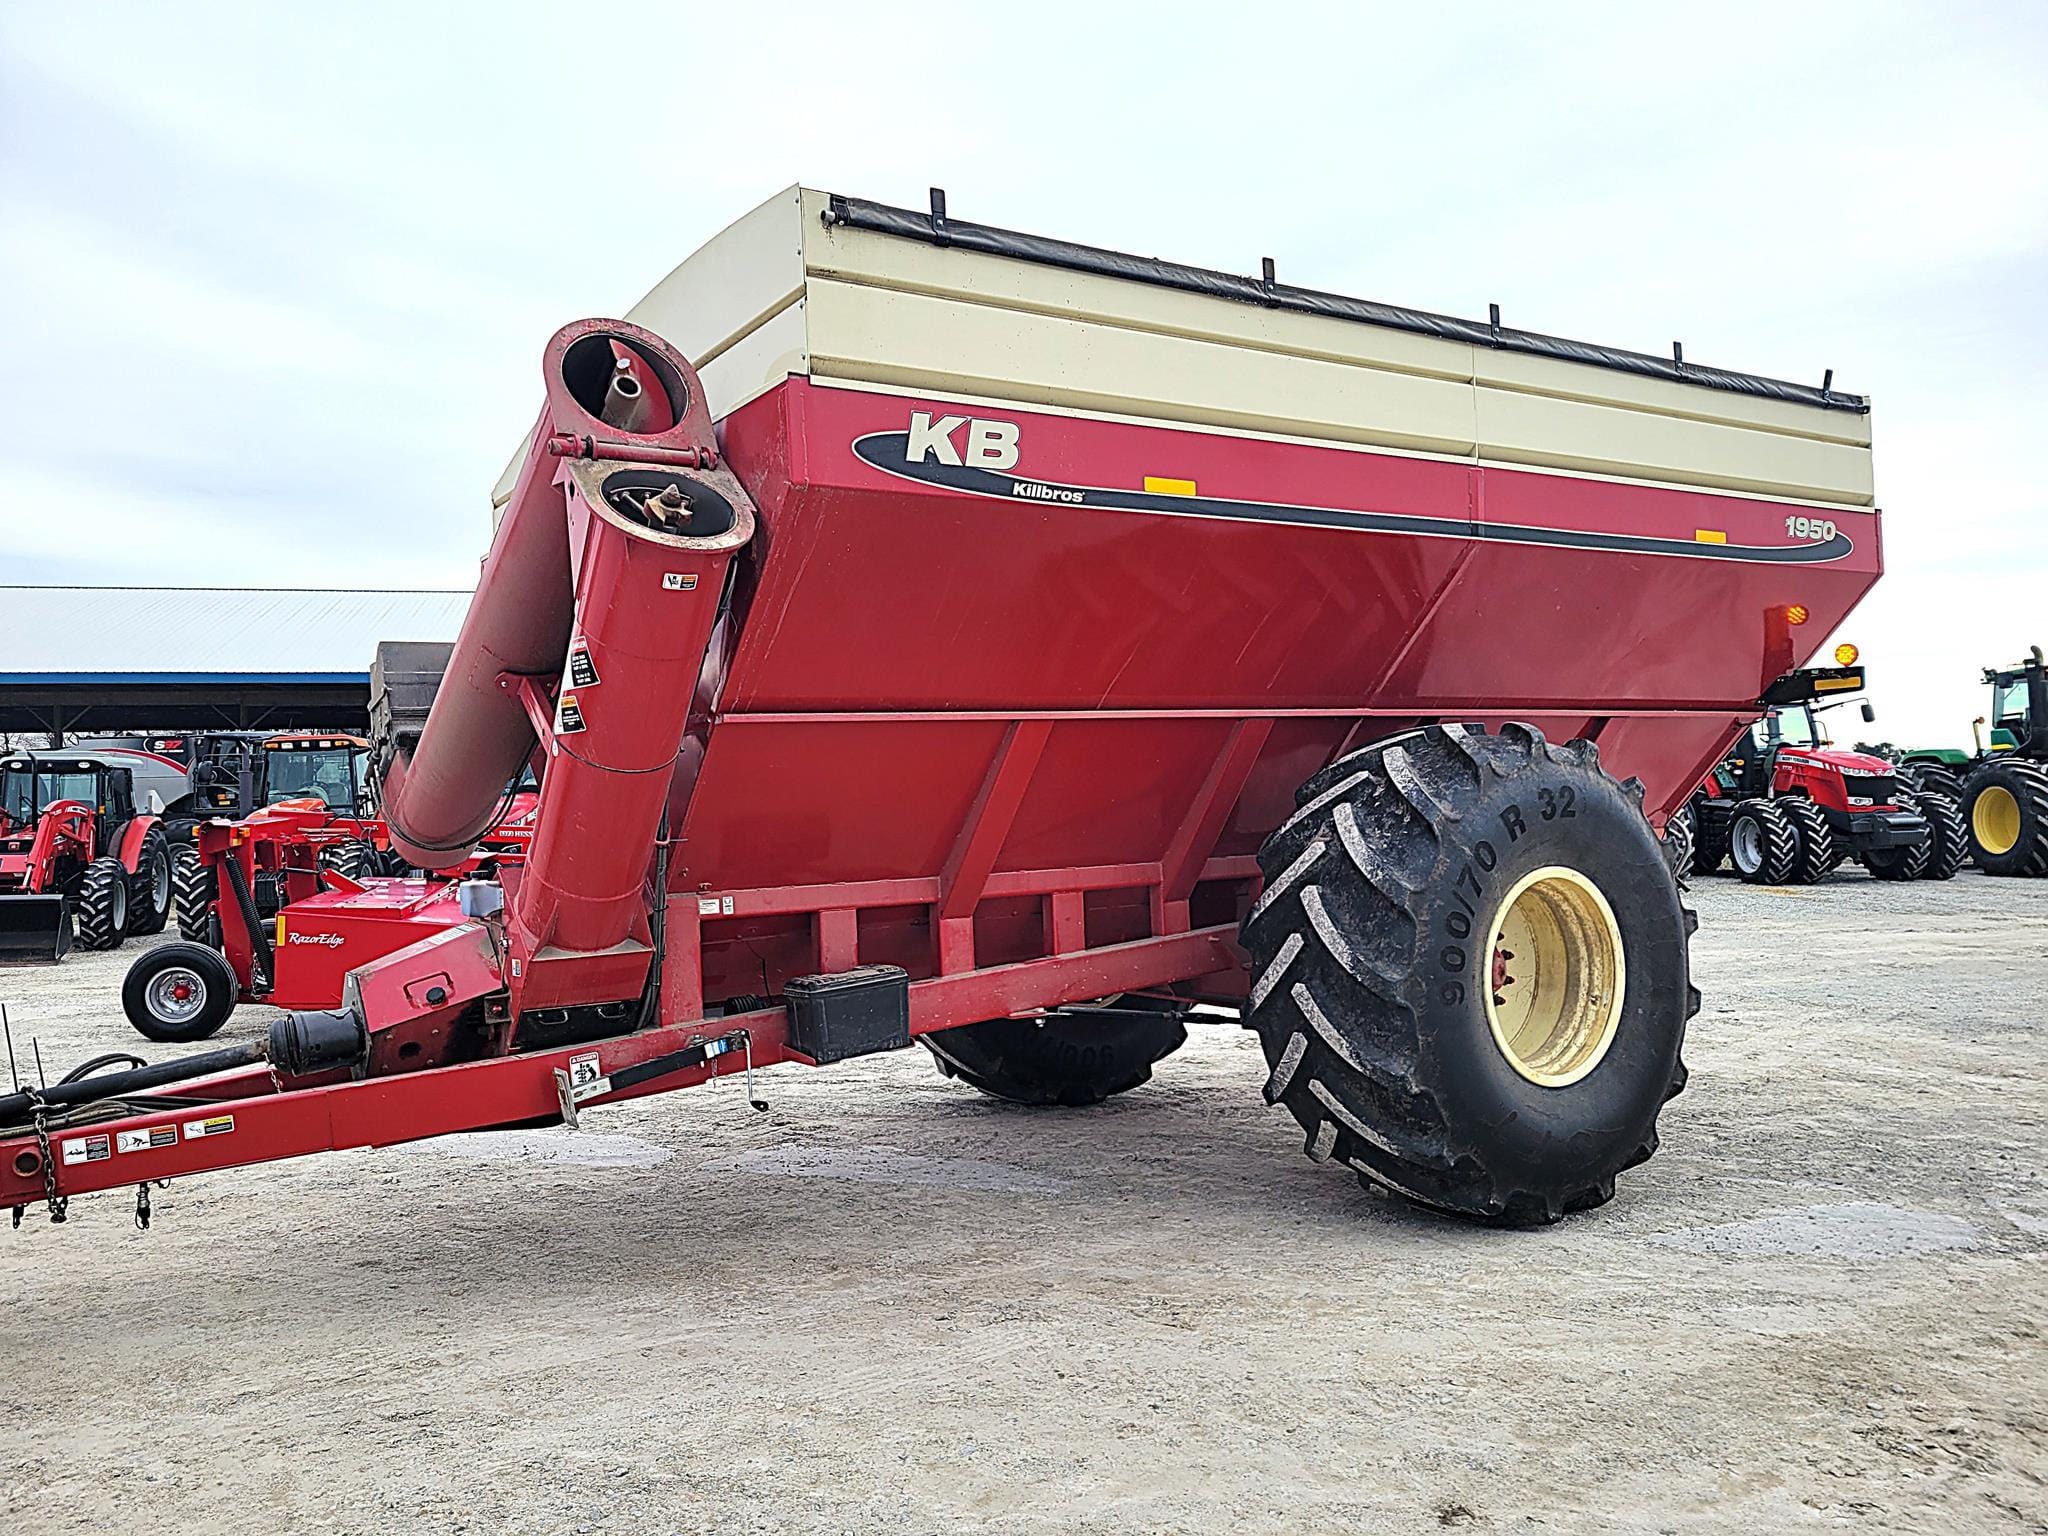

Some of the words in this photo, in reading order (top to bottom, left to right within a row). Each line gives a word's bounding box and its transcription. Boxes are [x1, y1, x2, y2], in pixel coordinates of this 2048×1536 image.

[906, 411, 1021, 470] KB
[1013, 481, 1083, 503] Killbros
[1785, 515, 1836, 541] 1950
[1440, 841, 1497, 1006] 900/70
[1500, 804, 1527, 842] R
[1538, 785, 1577, 821] 32
[288, 932, 345, 949] RazorEdge
